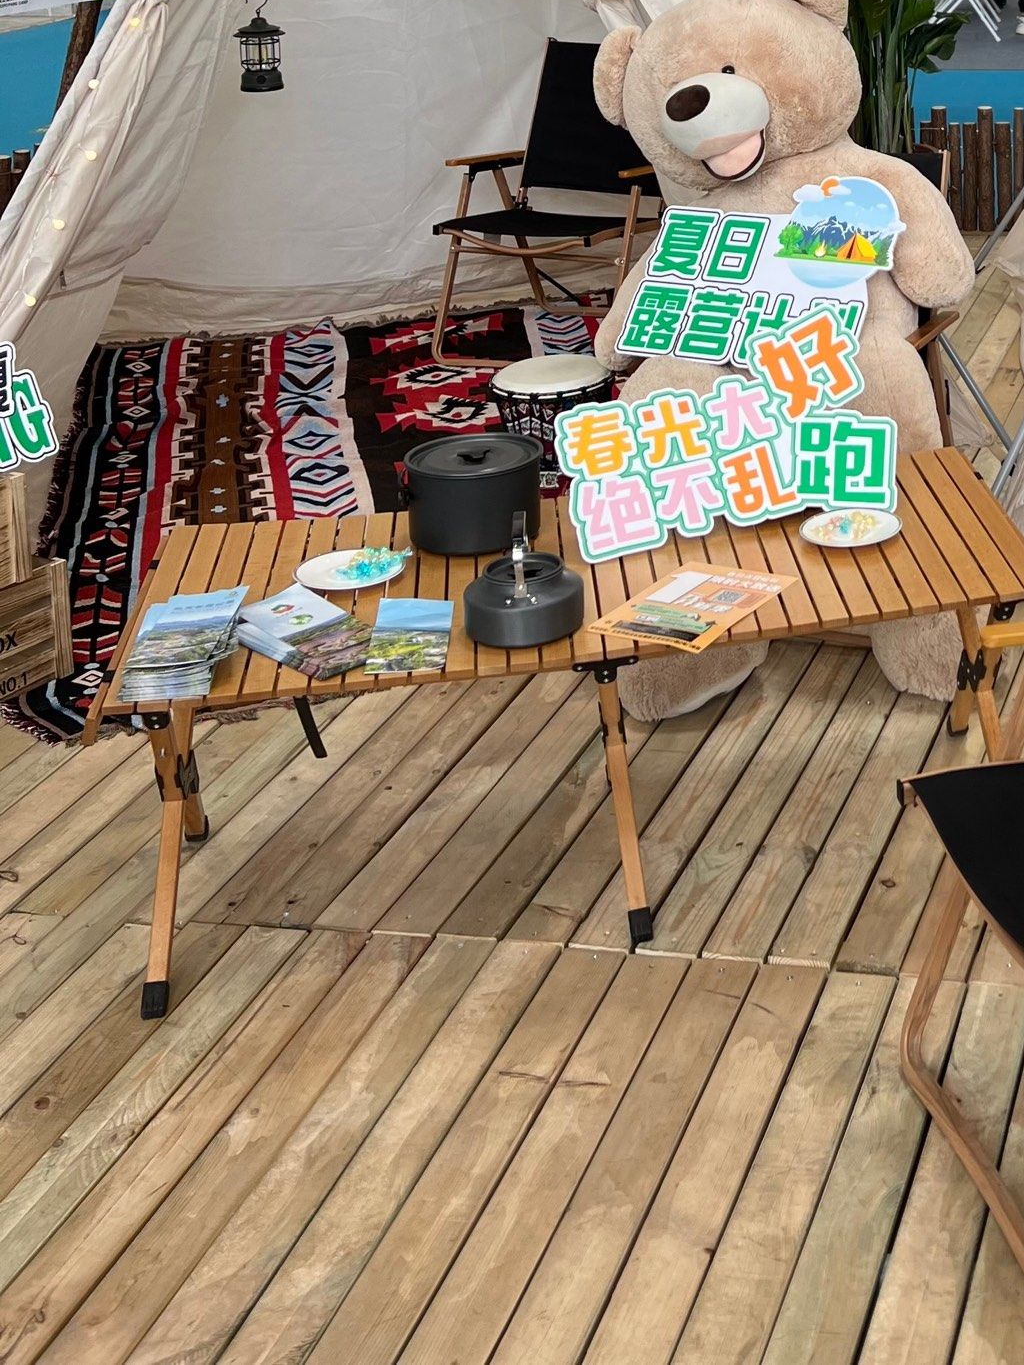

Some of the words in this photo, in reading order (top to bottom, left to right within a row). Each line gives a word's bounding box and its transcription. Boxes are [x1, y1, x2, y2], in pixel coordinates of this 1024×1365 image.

[652, 212, 770, 282] 夏日
[567, 316, 856, 477] 春光大好
[580, 421, 889, 552] 绝不乱跑
